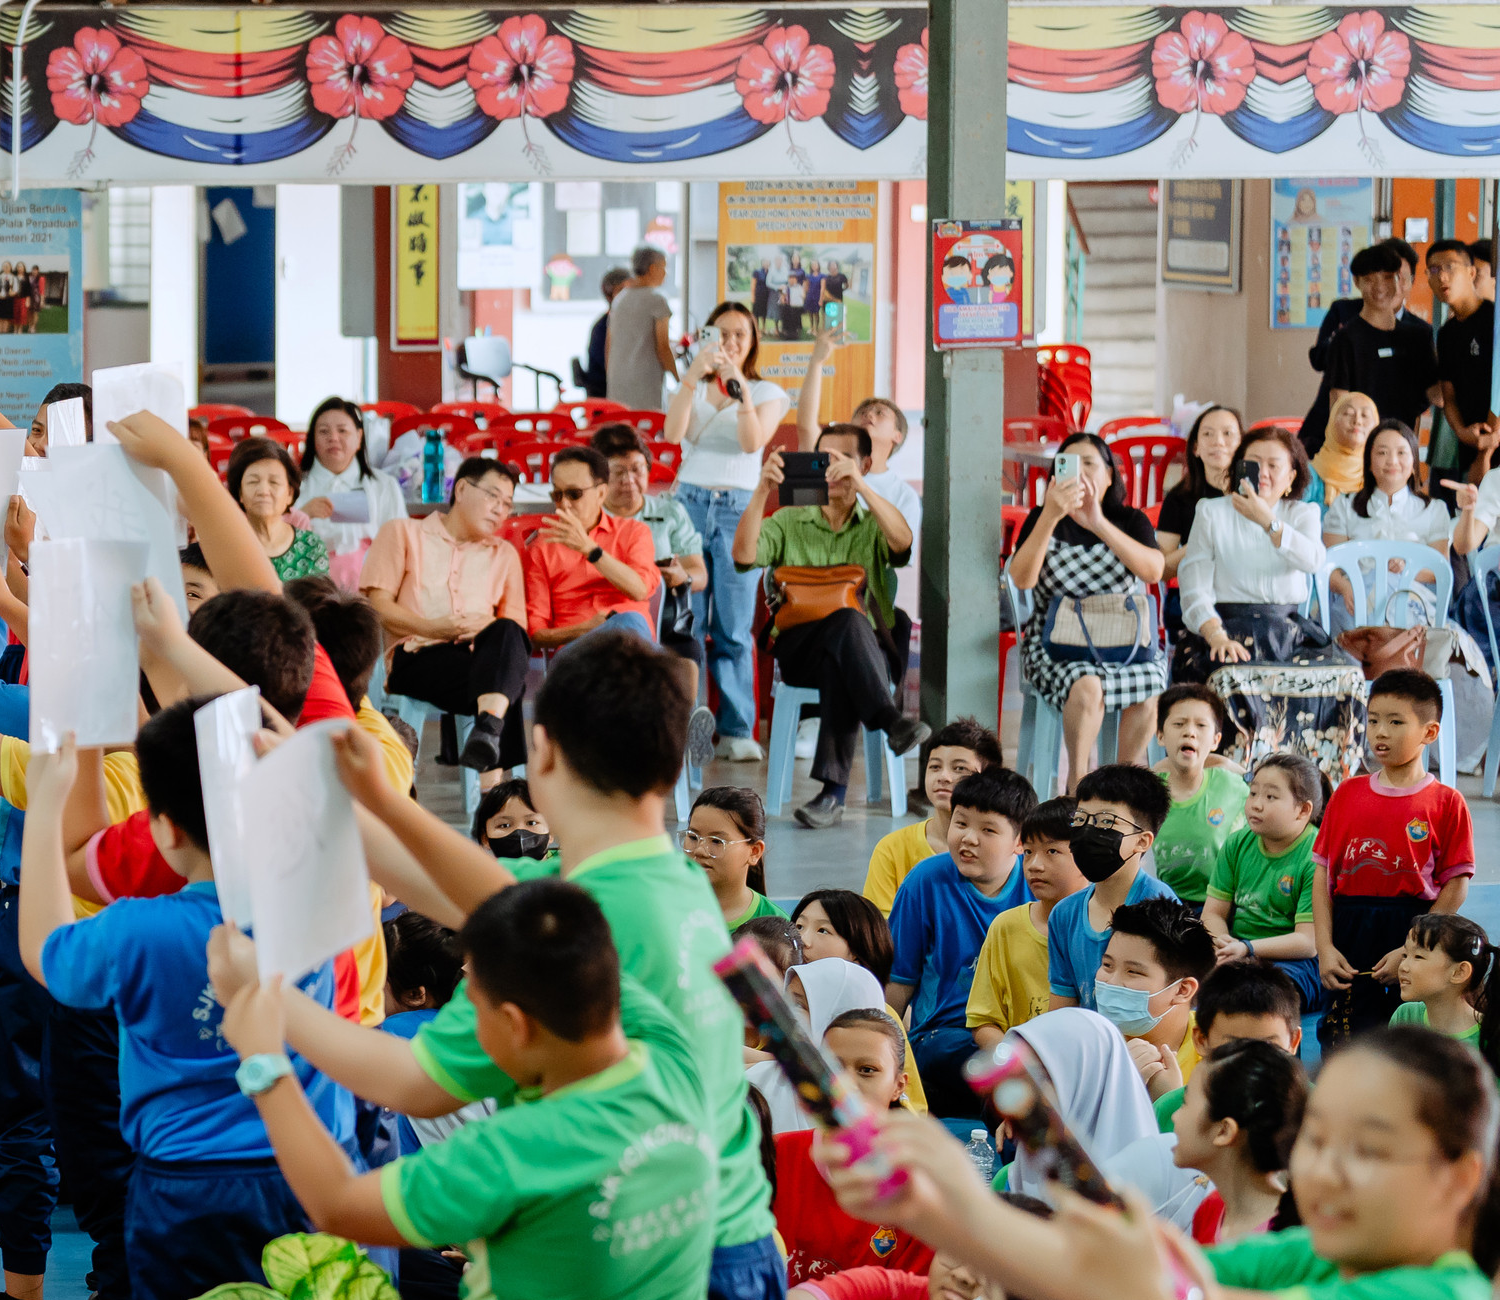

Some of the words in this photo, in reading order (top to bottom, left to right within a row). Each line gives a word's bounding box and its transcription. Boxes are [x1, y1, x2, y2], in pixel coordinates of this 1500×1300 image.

[2, 204, 27, 216] Ujian
[29, 204, 67, 214] Bertulis
[728, 209, 748, 218] YEAR
[768, 209, 788, 218] HONG
[791, 209, 812, 218] KONG
[814, 208, 872, 218] INTERNATIONAL
[0, 219, 23, 228] Piala
[26, 219, 79, 230] Perpaduan
[756, 221, 786, 230] SPEECH
[788, 221, 808, 230] OPEN
[809, 221, 844, 230] CONTEST
[31, 233, 52, 243] 2021
